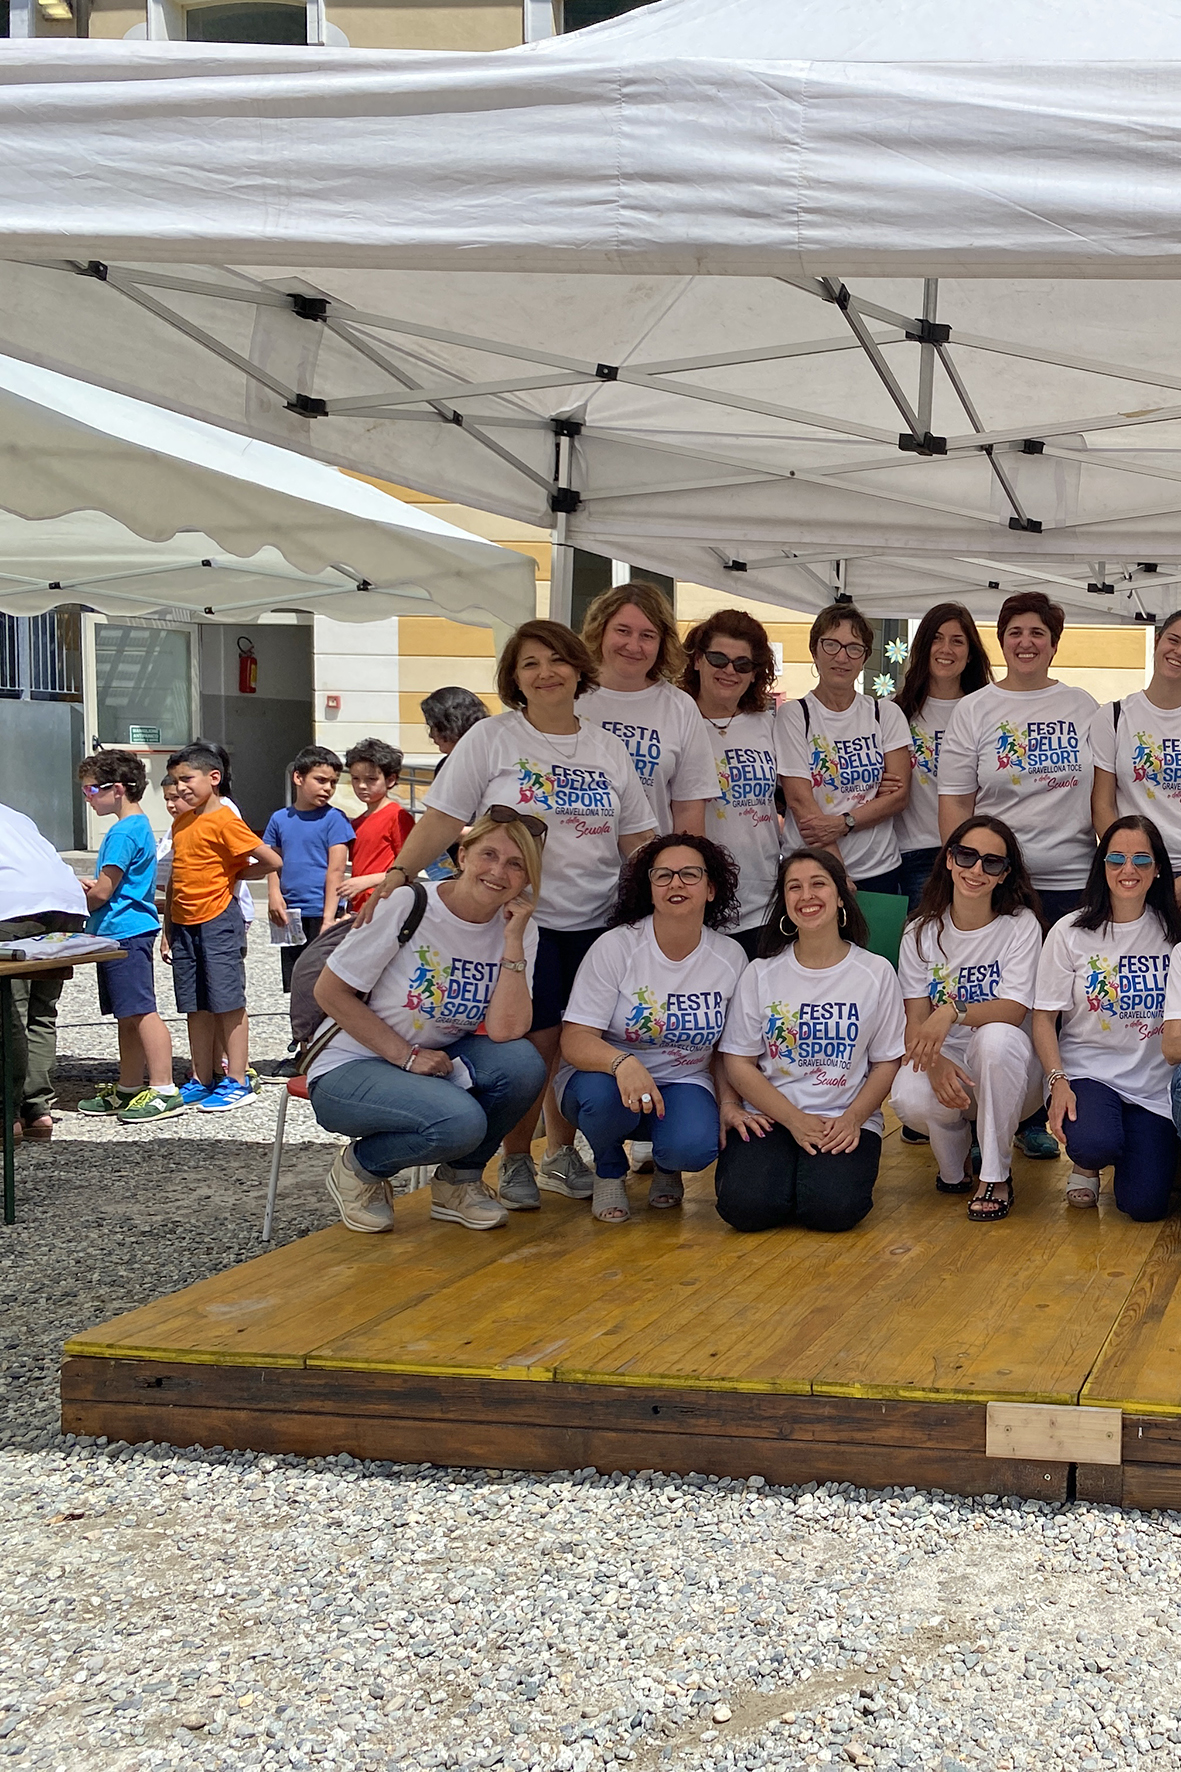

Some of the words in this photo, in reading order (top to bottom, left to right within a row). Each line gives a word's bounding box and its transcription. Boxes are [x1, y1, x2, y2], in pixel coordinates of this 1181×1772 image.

[1027, 720, 1077, 737] FESTA
[1028, 736, 1078, 752] DELLO
[725, 749, 773, 765] FESTA
[838, 751, 884, 770] DELLO
[1027, 750, 1079, 766] SPORT
[552, 765, 612, 783] FESTA
[729, 765, 776, 782] DELLO
[1028, 765, 1066, 774] GRAVELLONA
[1068, 764, 1082, 772] TOCE
[557, 777, 609, 791] DELLO
[1047, 776, 1078, 791] Scuola
[555, 791, 613, 808] SPORT
[555, 807, 599, 816] GRAVELLONA
[575, 822, 612, 838] Scuola
[450, 958, 501, 982] FEST
[447, 979, 491, 1004] DELL
[1119, 973, 1168, 993] DELL
[667, 992, 722, 1011] FESTA
[1120, 993, 1165, 1011] SPOR
[666, 1010, 722, 1031] DELLO
[799, 1003, 859, 1021] FESTA
[662, 1030, 721, 1045] SPORT
[799, 1022, 858, 1042] DELLO
[798, 1042, 855, 1060] SPORT
[798, 1059, 837, 1067] GRAVELLONA
[812, 1072, 847, 1087] Scuola
